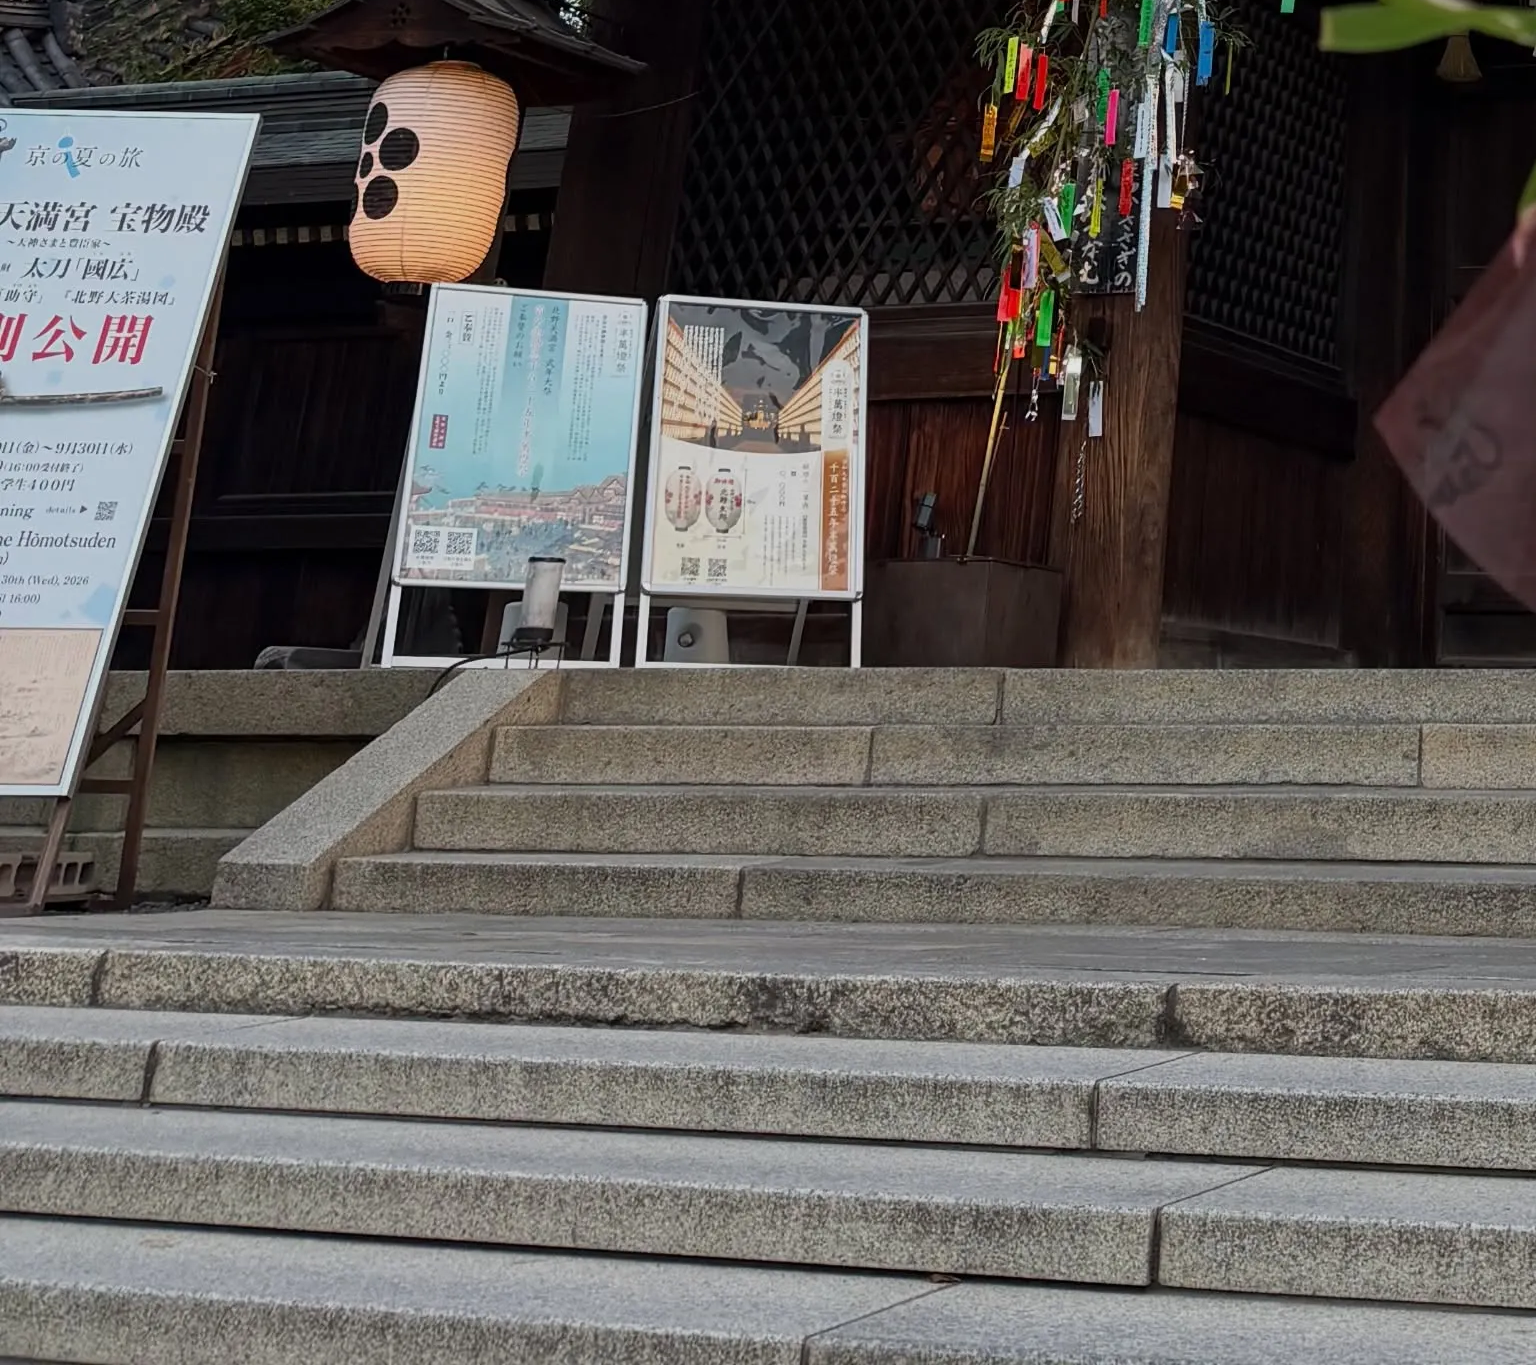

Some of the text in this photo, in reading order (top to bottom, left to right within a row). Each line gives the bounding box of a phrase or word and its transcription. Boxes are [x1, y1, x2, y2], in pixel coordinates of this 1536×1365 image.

[25, 145, 144, 168] 京の夏の旅
[0, 201, 210, 233] 天満宮 宝物殿
[63, 575, 90, 586] 2026
